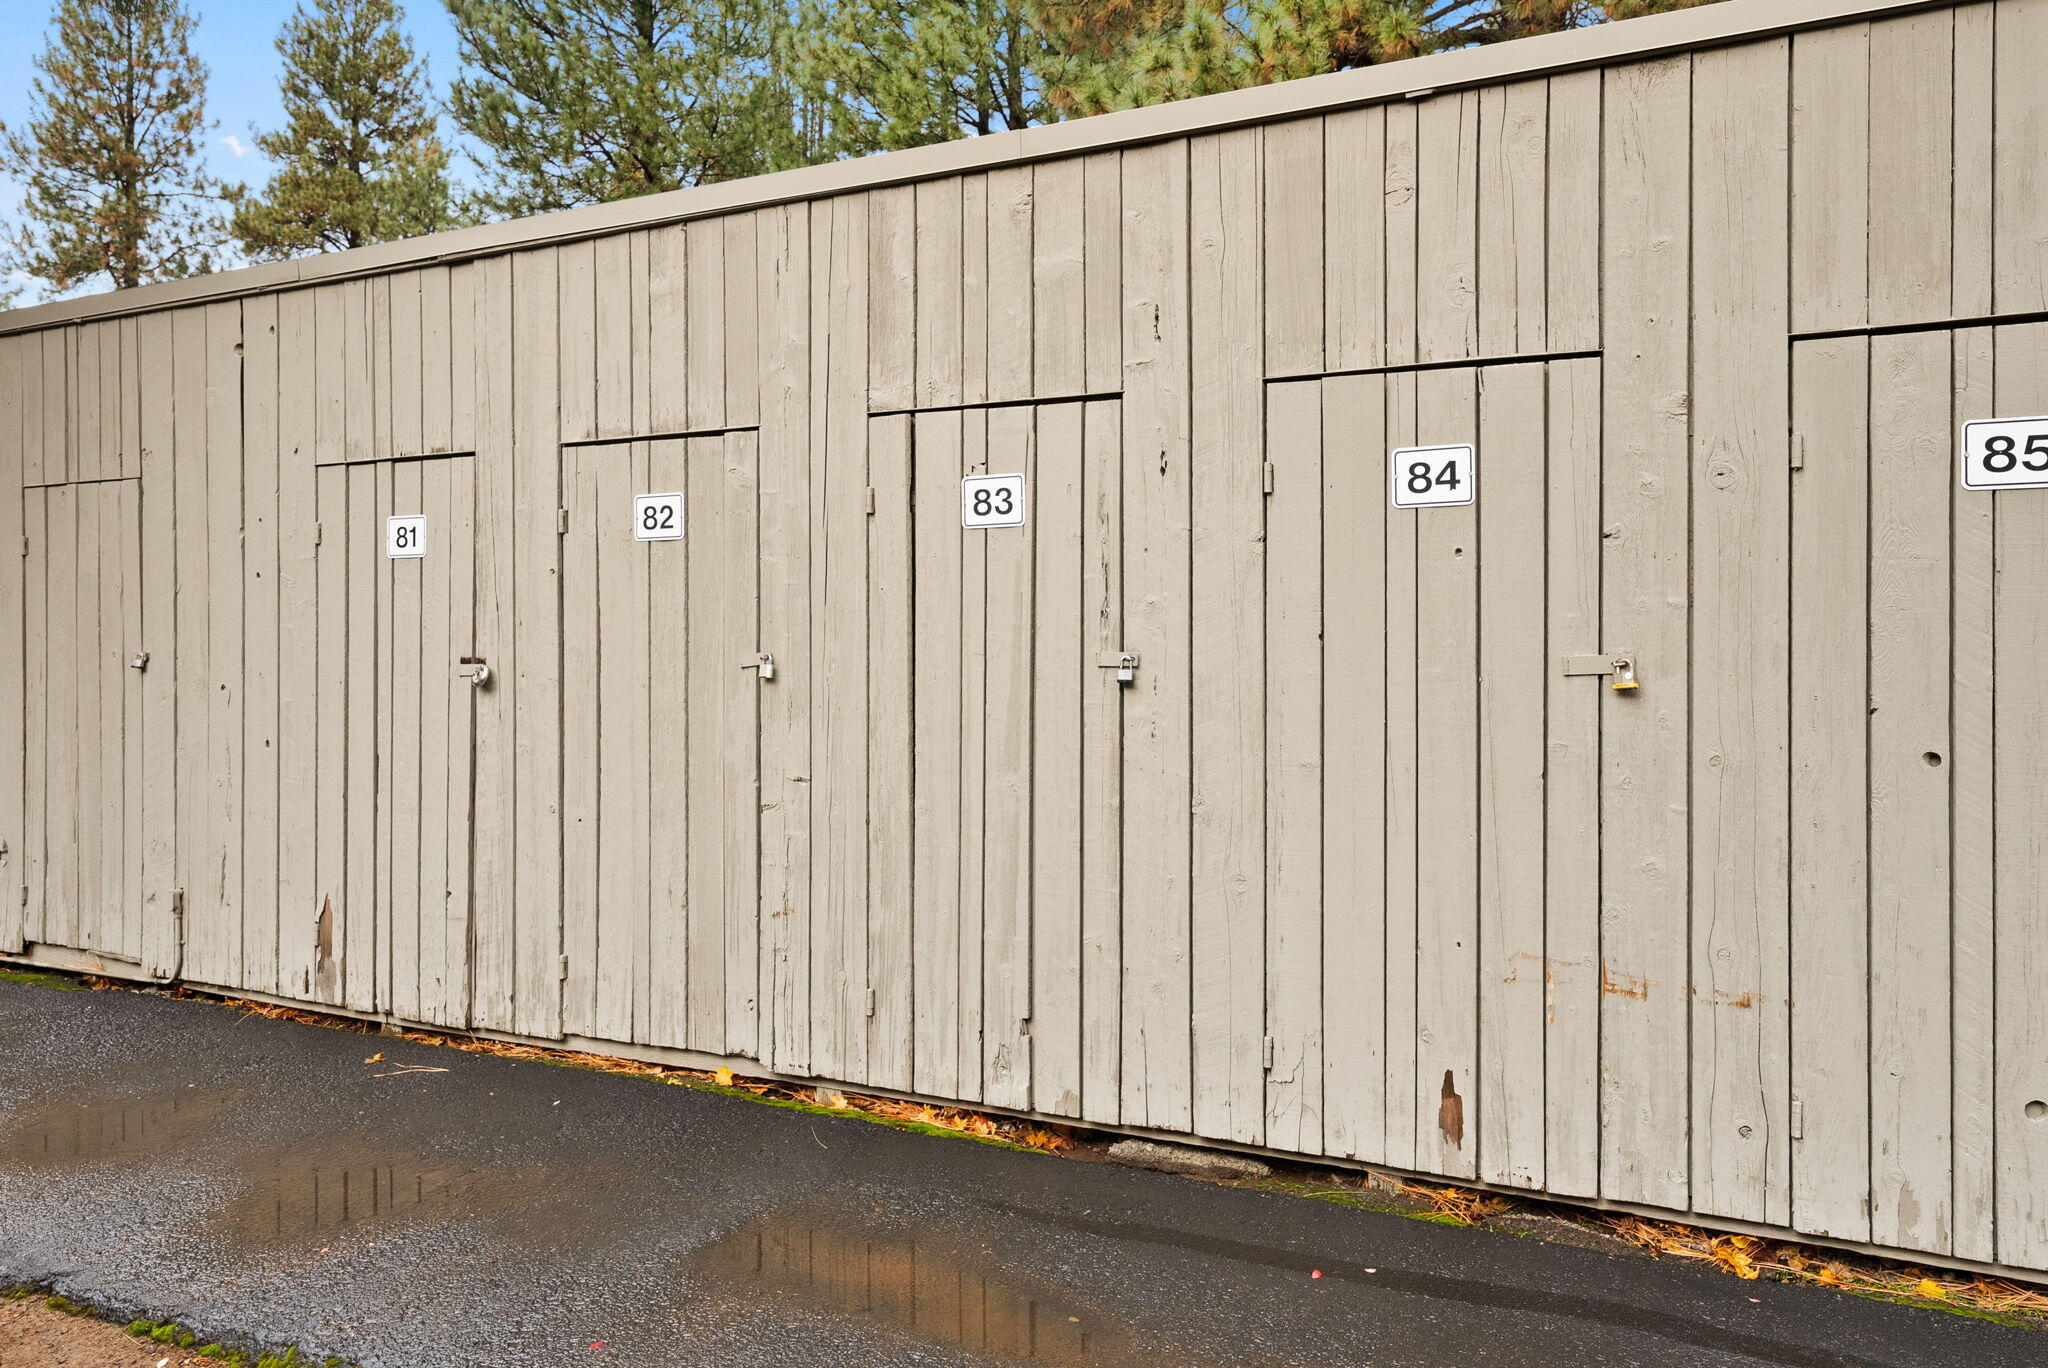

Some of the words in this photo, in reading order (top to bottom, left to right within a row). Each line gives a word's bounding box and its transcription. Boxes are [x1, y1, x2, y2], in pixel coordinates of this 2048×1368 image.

[1983, 434, 2048, 473] 85
[1407, 460, 1461, 494] 84
[973, 487, 1013, 516] 83
[643, 505, 674, 531] 82
[396, 526, 417, 548] 81
